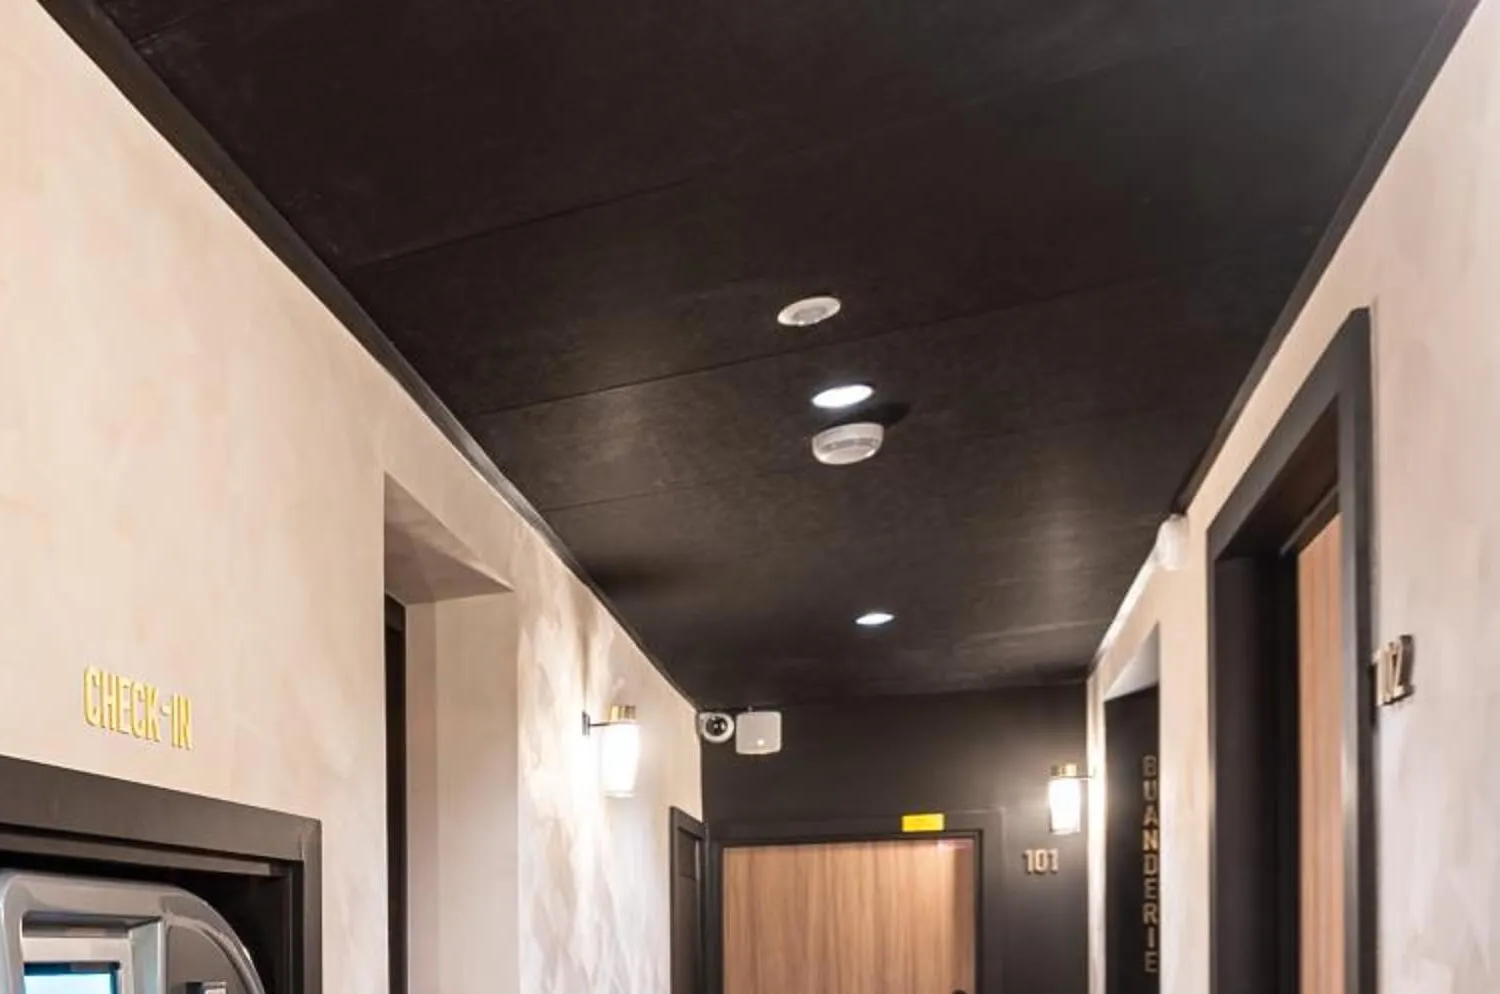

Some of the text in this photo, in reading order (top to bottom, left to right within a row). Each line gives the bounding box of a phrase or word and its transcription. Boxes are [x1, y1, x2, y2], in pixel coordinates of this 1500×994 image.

[84, 665, 193, 750] CHECK-IN
[1023, 849, 1059, 874] 101
[1142, 754, 1158, 973] BUANDERIE
